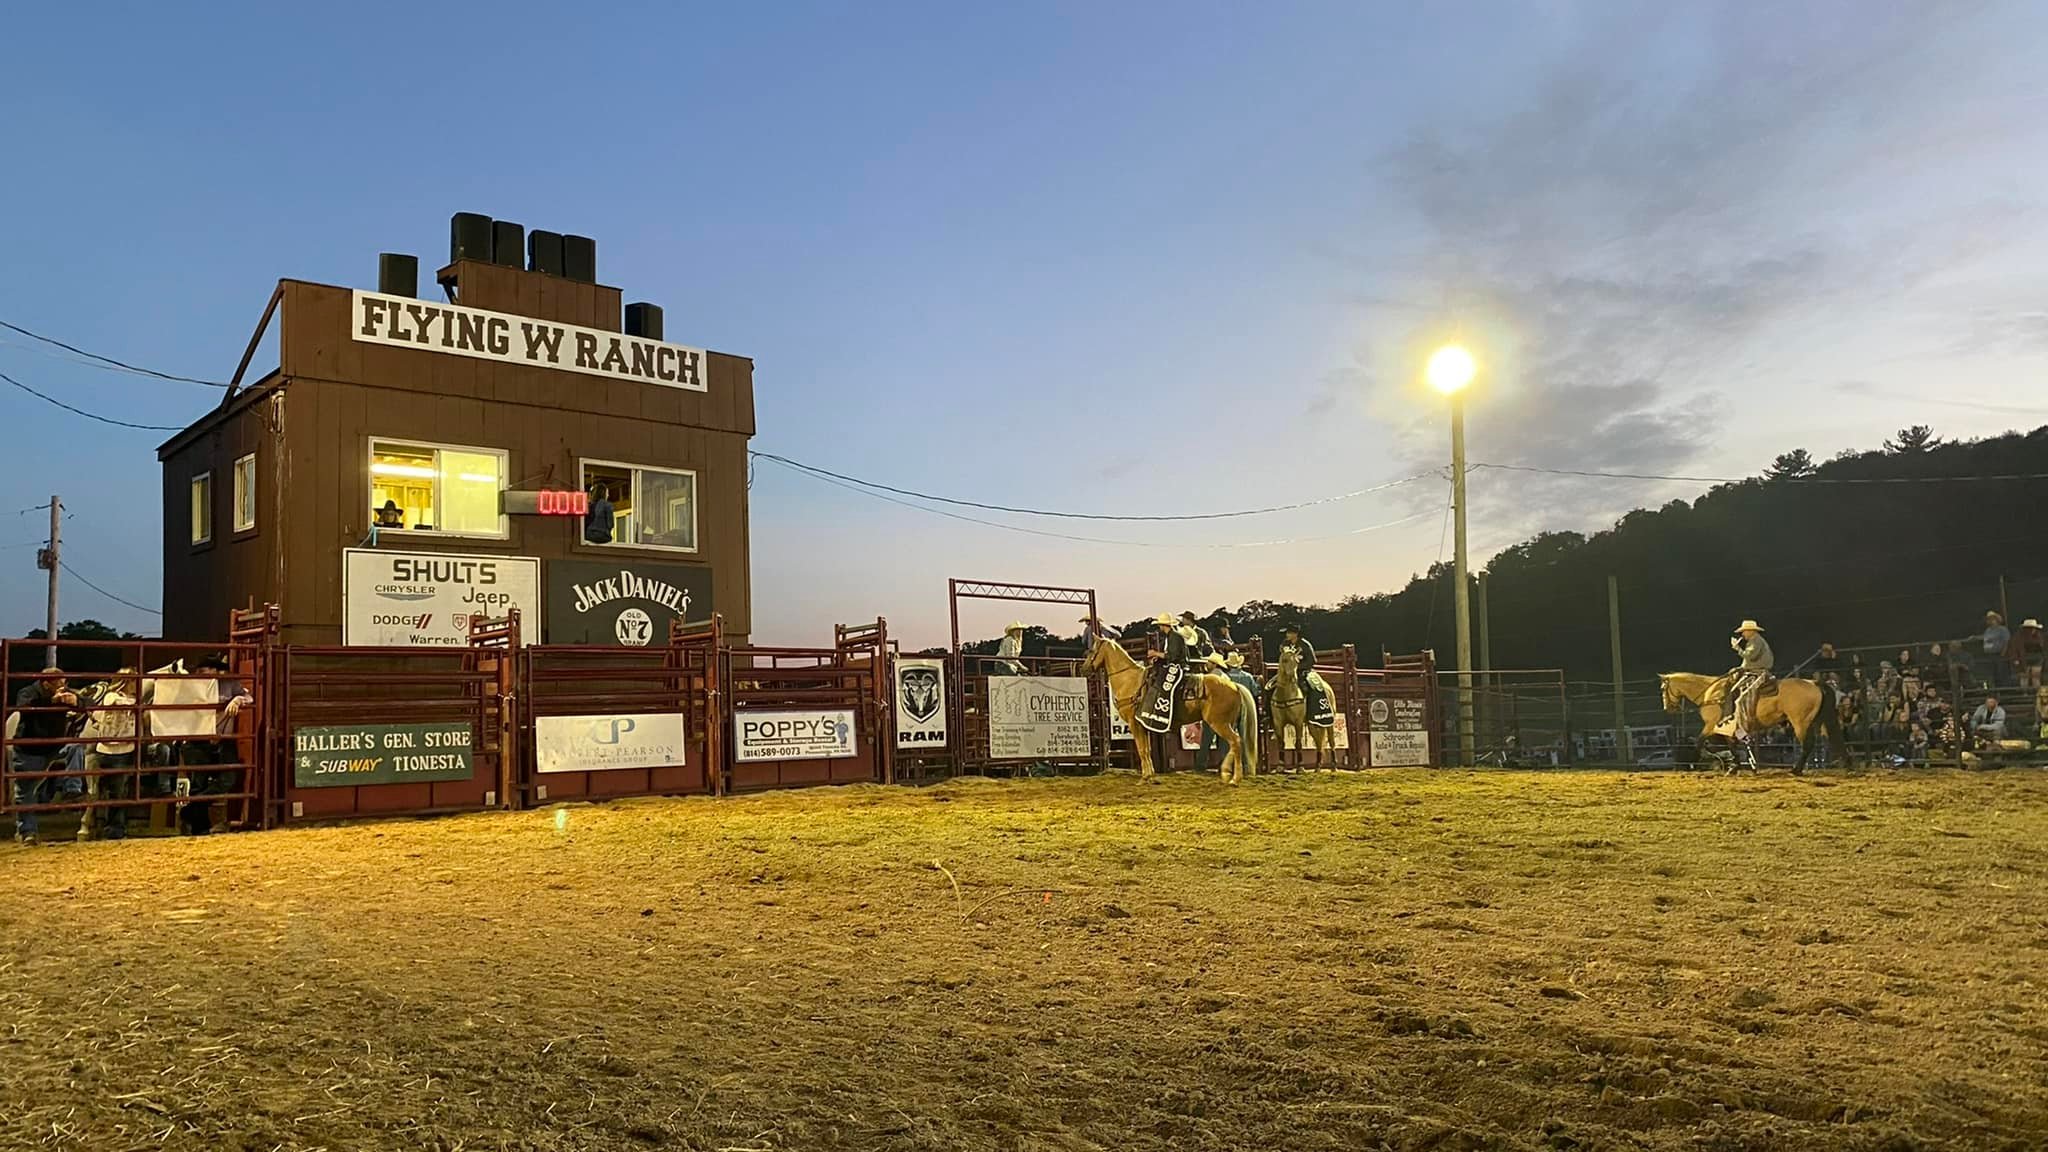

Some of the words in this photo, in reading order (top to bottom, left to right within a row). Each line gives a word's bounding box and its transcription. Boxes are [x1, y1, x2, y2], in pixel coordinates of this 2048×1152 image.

[362, 297, 509, 355] FLYING
[521, 322, 565, 363] W
[575, 331, 700, 386] RANCH
[393, 559, 496, 584] SHULTS
[374, 584, 436, 594] CHRYSLER
[462, 587, 510, 608] Jeep
[572, 577, 621, 613] JACK
[620, 570, 692, 615] DANIEL'S
[373, 614, 420, 626] DODGE
[743, 715, 835, 739] POPPY'S
[1034, 711, 1051, 722] TREE
[1054, 711, 1083, 722] SERVICE
[296, 731, 375, 752] HALLER'S
[383, 732, 417, 749] GEN.
[424, 731, 471, 748] STORE
[898, 731, 945, 742] RAM
[301, 756, 311, 768] &
[315, 757, 384, 774] SUBWAY
[393, 754, 466, 772] TIONESTA
